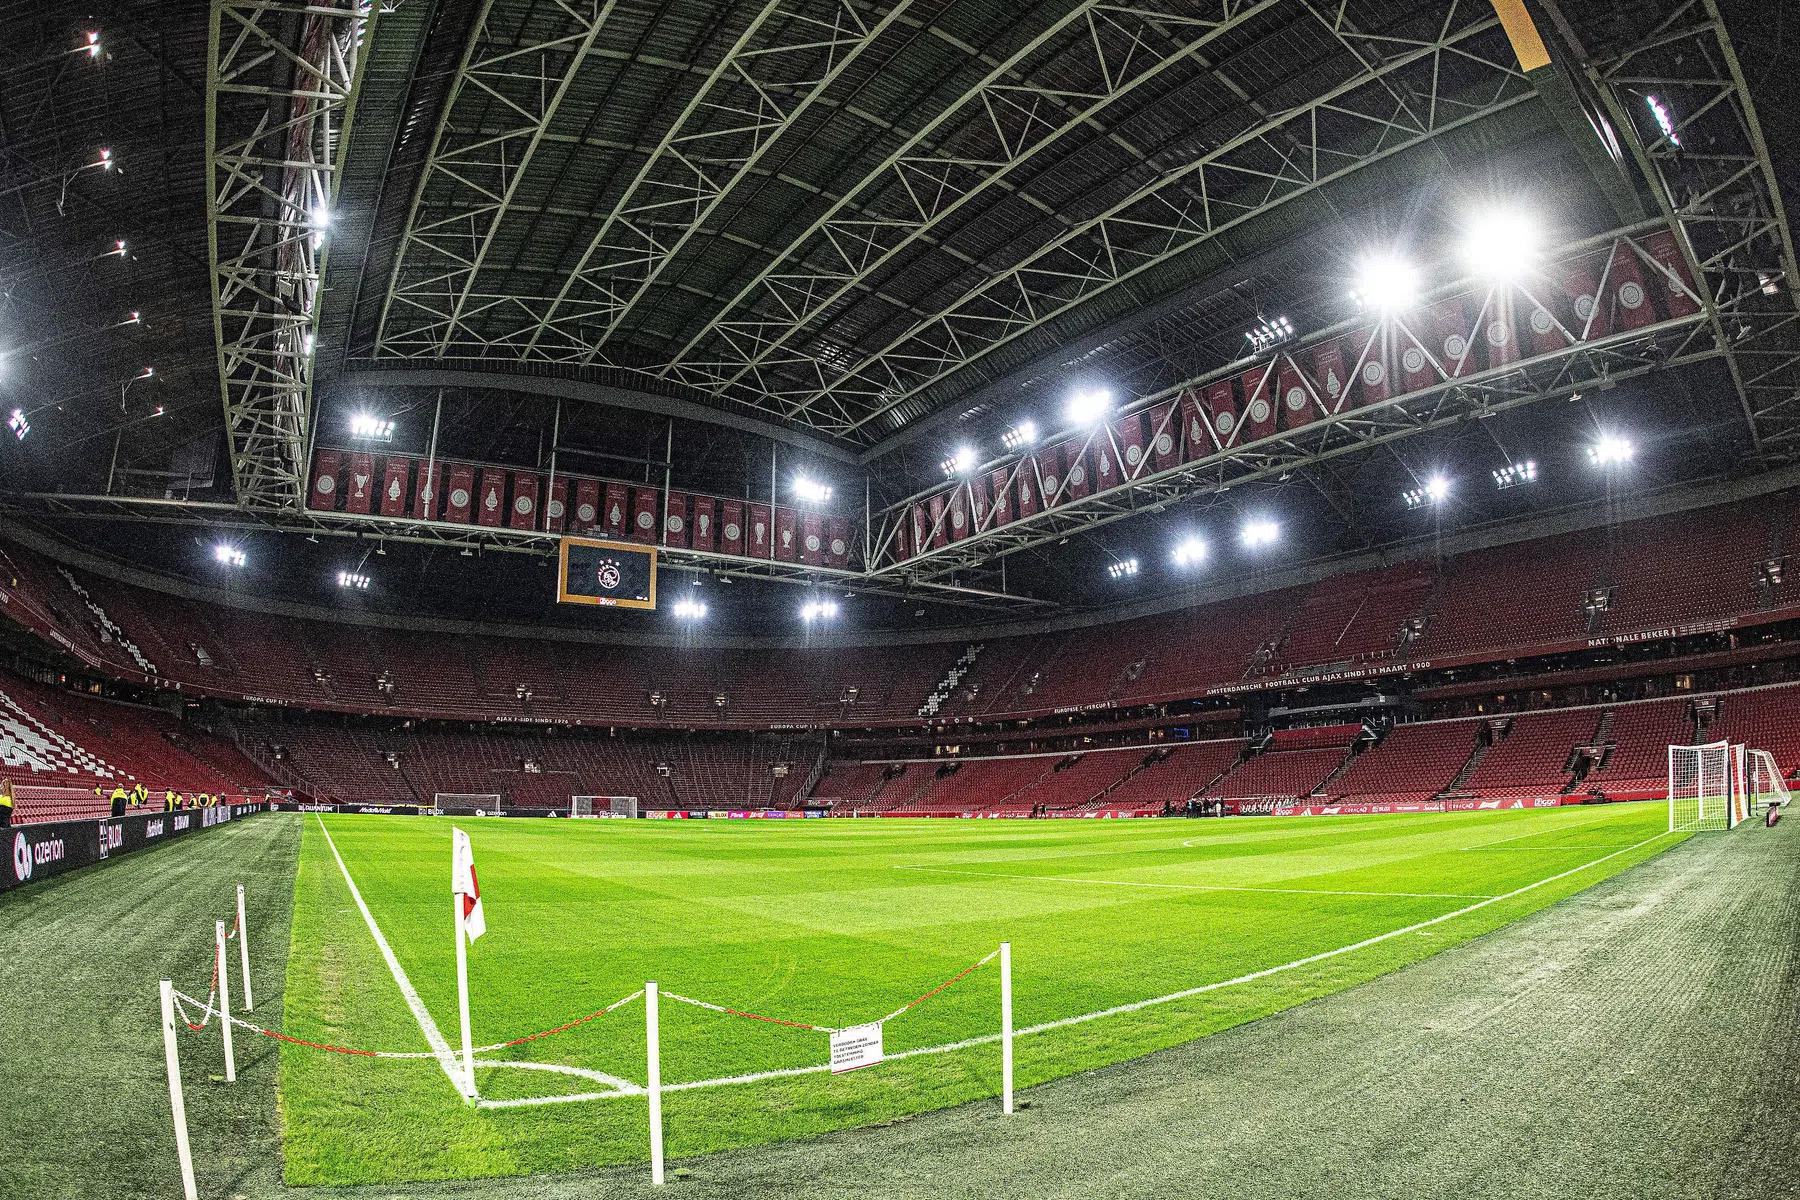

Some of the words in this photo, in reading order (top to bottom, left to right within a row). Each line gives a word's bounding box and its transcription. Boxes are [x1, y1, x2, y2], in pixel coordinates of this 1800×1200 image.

[1641, 629, 1669, 640] BEKER
[1206, 683, 1262, 695] AMSTERDAMSCHE
[1265, 678, 1300, 688] FOOTBALL
[1303, 675, 1320, 683] CLUB
[1322, 672, 1341, 681] AJAX
[1344, 669, 1365, 678] SINDS
[1380, 664, 1407, 674] MAART
[1412, 661, 1431, 670] 1900
[34, 832, 65, 865] azerion
